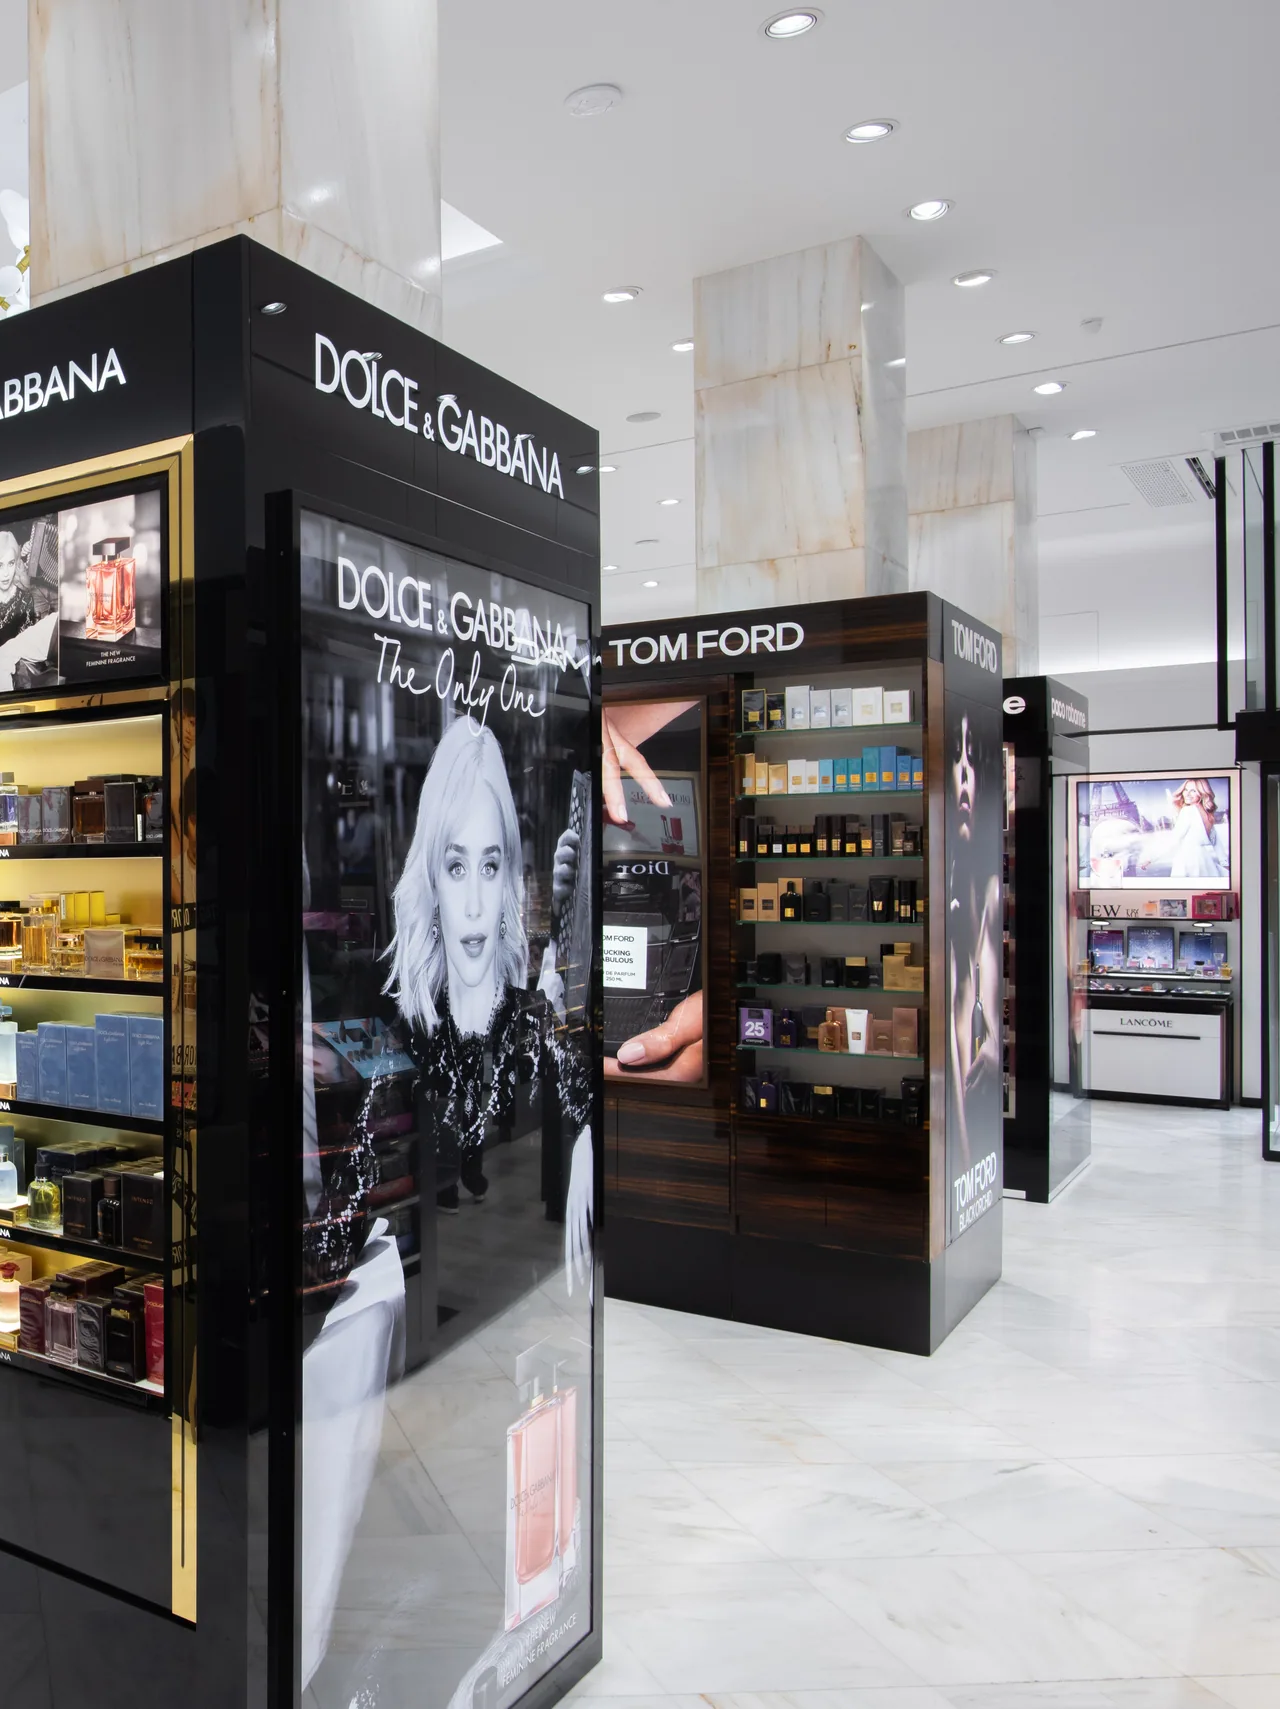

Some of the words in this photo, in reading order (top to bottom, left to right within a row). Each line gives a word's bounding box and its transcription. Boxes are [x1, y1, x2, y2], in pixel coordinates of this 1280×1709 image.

[315, 333, 418, 433] DOLCE
[423, 412, 435, 441] &
[438, 398, 564, 500] GABBANA
[338, 556, 432, 631] DOLCE
[437, 609, 448, 635] &
[450, 591, 566, 664] GABBANA
[86, 658, 107, 667] FEMININE
[107, 655, 136, 664] FRAGRANCE
[608, 632, 688, 667] TOM
[696, 622, 805, 659] FORD
[951, 619, 973, 663] TOM
[973, 632, 998, 674] FORD
[373, 632, 431, 694] The
[435, 648, 495, 738] Only
[500, 663, 546, 718] One
[1051, 697, 1065, 719] paco
[1065, 703, 1086, 728] rabanne
[613, 934, 635, 943] FORD
[1120, 1017, 1173, 1029] LANCÔME
[954, 1167, 974, 1211] TOM
[974, 1151, 997, 1196] FORD
[536, 1612, 578, 1658] FRAGRANCE
